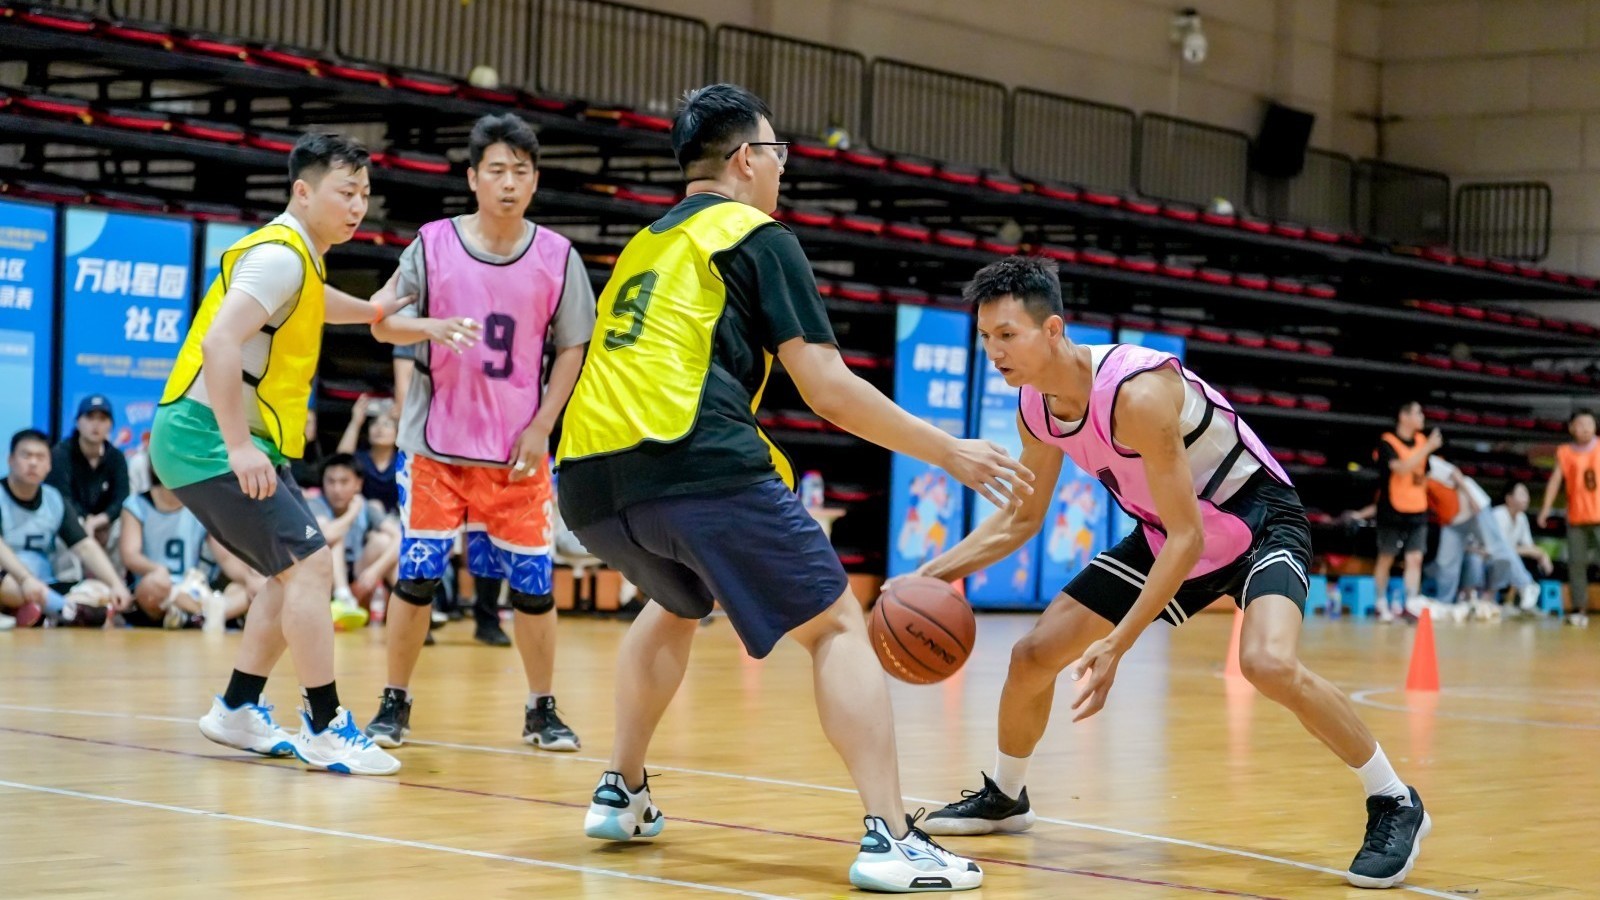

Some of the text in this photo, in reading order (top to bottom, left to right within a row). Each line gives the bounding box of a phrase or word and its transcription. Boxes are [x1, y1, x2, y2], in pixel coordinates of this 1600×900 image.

[0, 257, 26, 282] 区
[74, 257, 188, 299] 万科星园
[124, 305, 183, 343] 社区
[604, 268, 660, 352] 9
[483, 311, 516, 379] 9
[164, 538, 185, 576] 9
